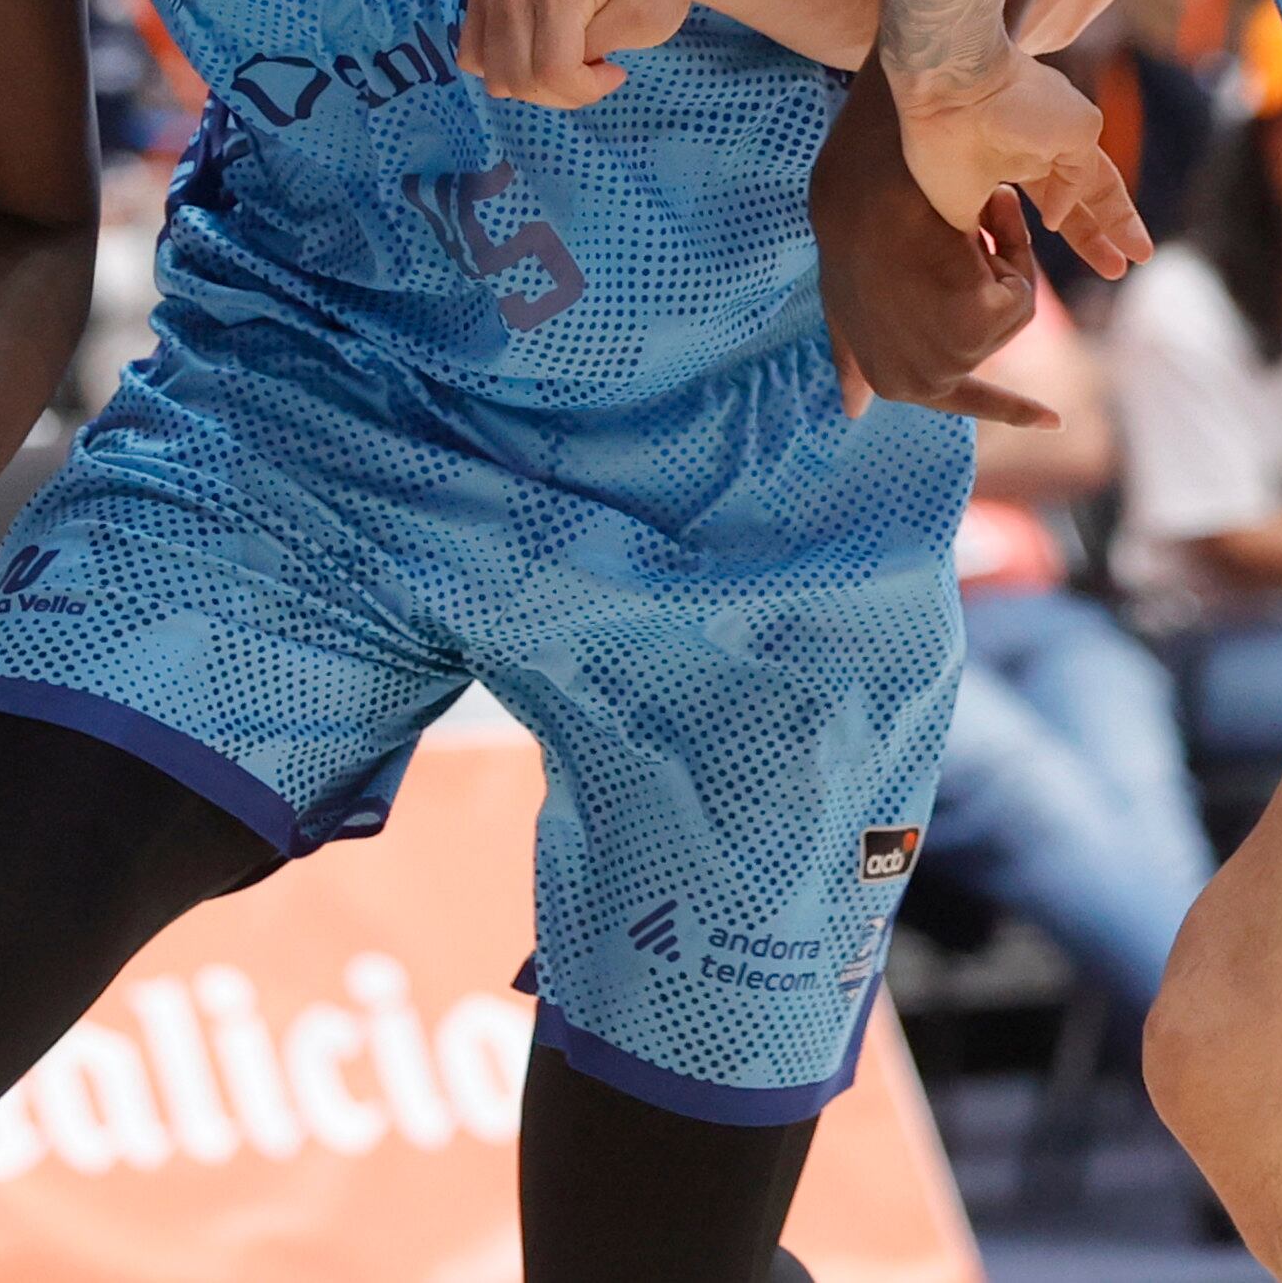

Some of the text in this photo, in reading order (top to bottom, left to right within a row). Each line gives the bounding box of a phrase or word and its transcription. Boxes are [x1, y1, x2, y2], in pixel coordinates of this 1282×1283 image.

[18, 593, 88, 616] Vella
[867, 847, 906, 875] acb
[708, 927, 821, 960] andorra
[701, 954, 816, 992] telecom
